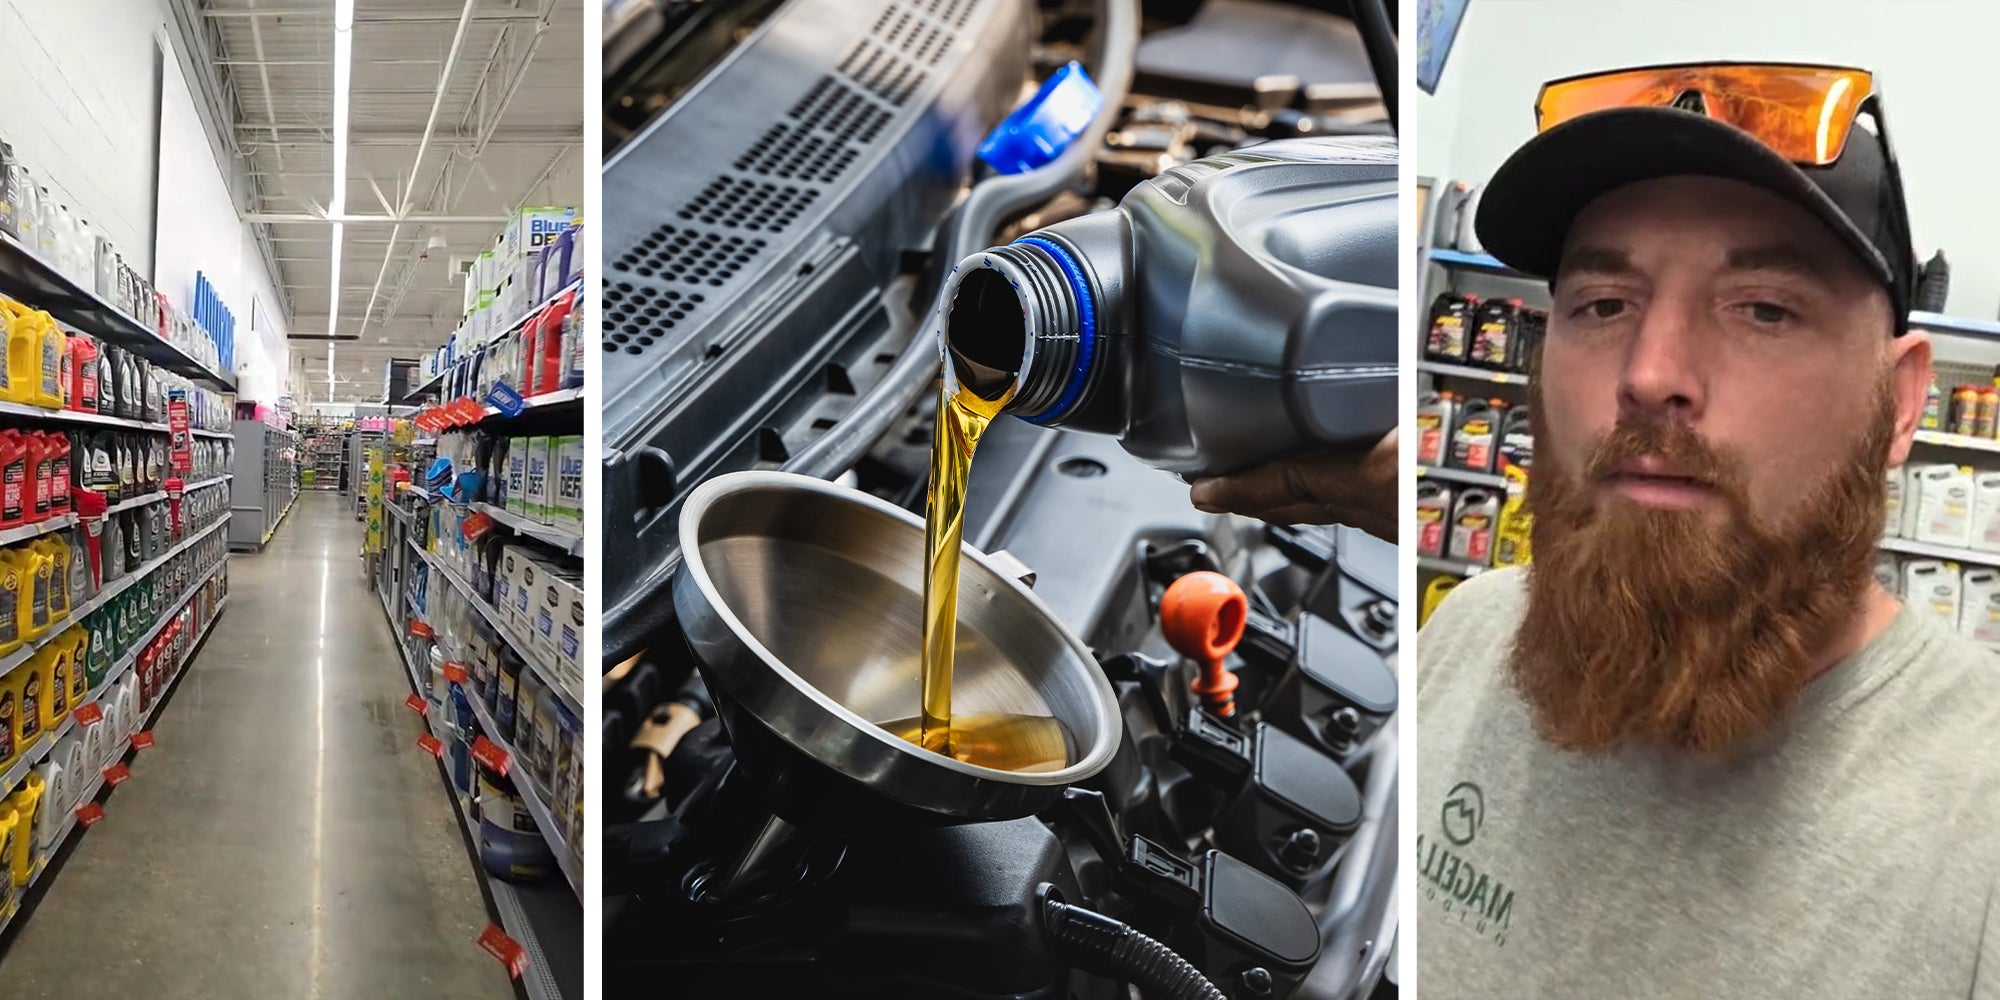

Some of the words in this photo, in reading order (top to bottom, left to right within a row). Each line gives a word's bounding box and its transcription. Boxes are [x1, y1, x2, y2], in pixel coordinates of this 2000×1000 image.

[531, 219, 571, 232] Blue
[531, 233, 560, 246] DE
[528, 475, 544, 497] DEF
[560, 475, 582, 499] DEF
